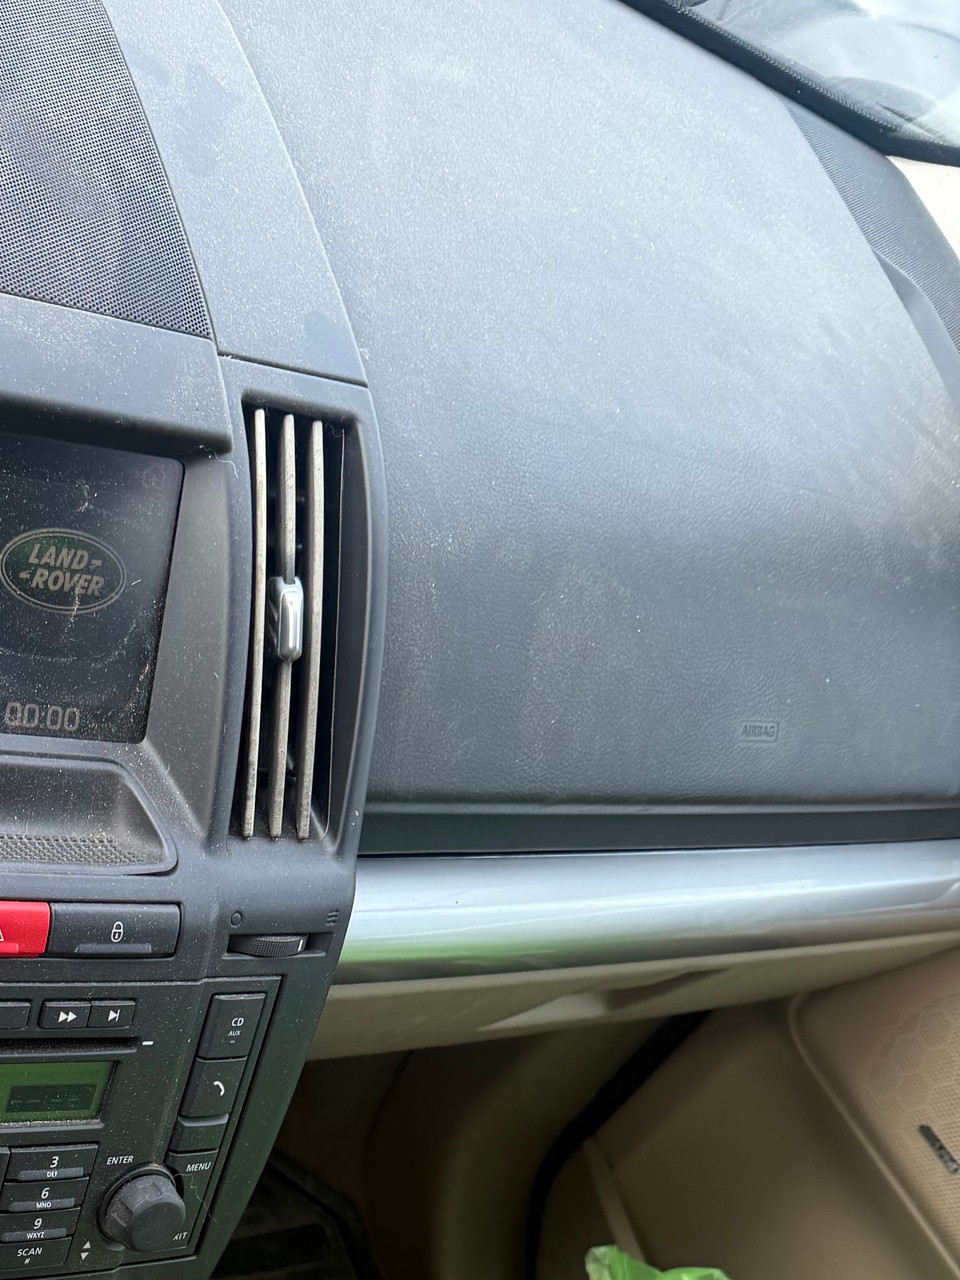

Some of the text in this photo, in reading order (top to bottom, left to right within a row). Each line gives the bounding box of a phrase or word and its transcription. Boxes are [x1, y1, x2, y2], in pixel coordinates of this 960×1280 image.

[29, 543, 89, 570] LAND
[31, 568, 104, 596] ROVER
[5, 701, 81, 731] 00:00
[231, 1017, 245, 1027] CD
[50, 1156, 59, 1168] 3
[106, 1155, 133, 1165] ENTER
[186, 1162, 211, 1172] MENU
[46, 1170, 58, 1178] DEF
[41, 1187, 50, 1199] 6
[36, 1201, 52, 1209] MNO
[33, 1218, 42, 1230] 9
[17, 1247, 42, 1257] SCAN
